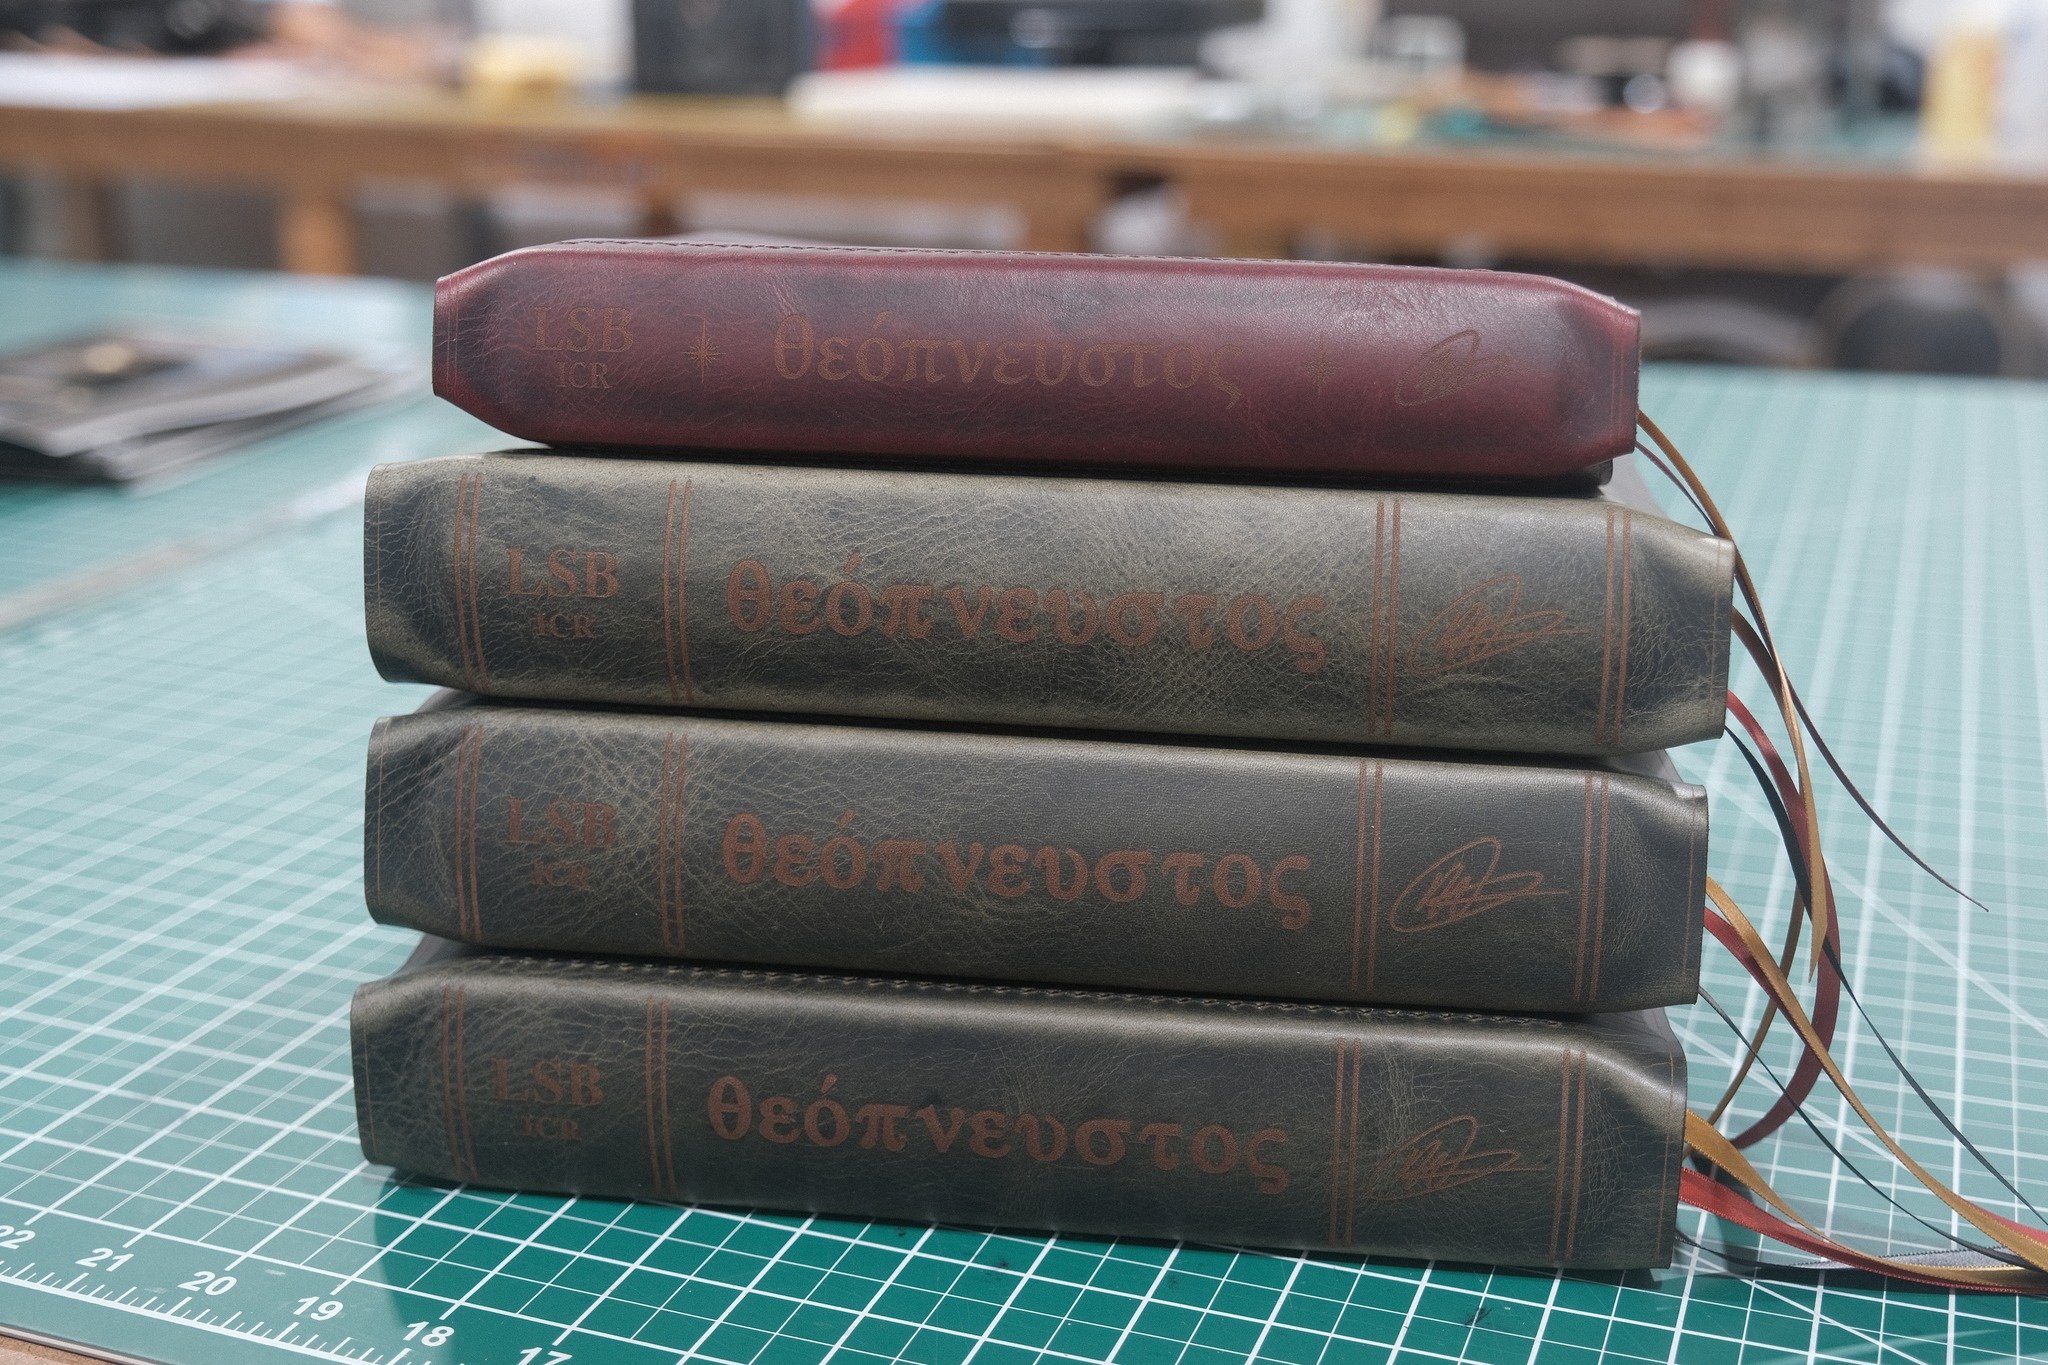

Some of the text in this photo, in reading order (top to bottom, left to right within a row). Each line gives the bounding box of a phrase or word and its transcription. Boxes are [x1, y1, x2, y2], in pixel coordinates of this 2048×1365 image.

[533, 306, 635, 354] LSB
[556, 361, 611, 390] ICR
[506, 548, 620, 599] LSB
[536, 612, 596, 639] ICR
[507, 798, 620, 850] LSB
[493, 1057, 602, 1107] LSB
[75, 1247, 134, 1272] 21
[179, 1271, 236, 1296] 20
[294, 1296, 343, 1321] 19
[402, 1321, 455, 1347] 18
